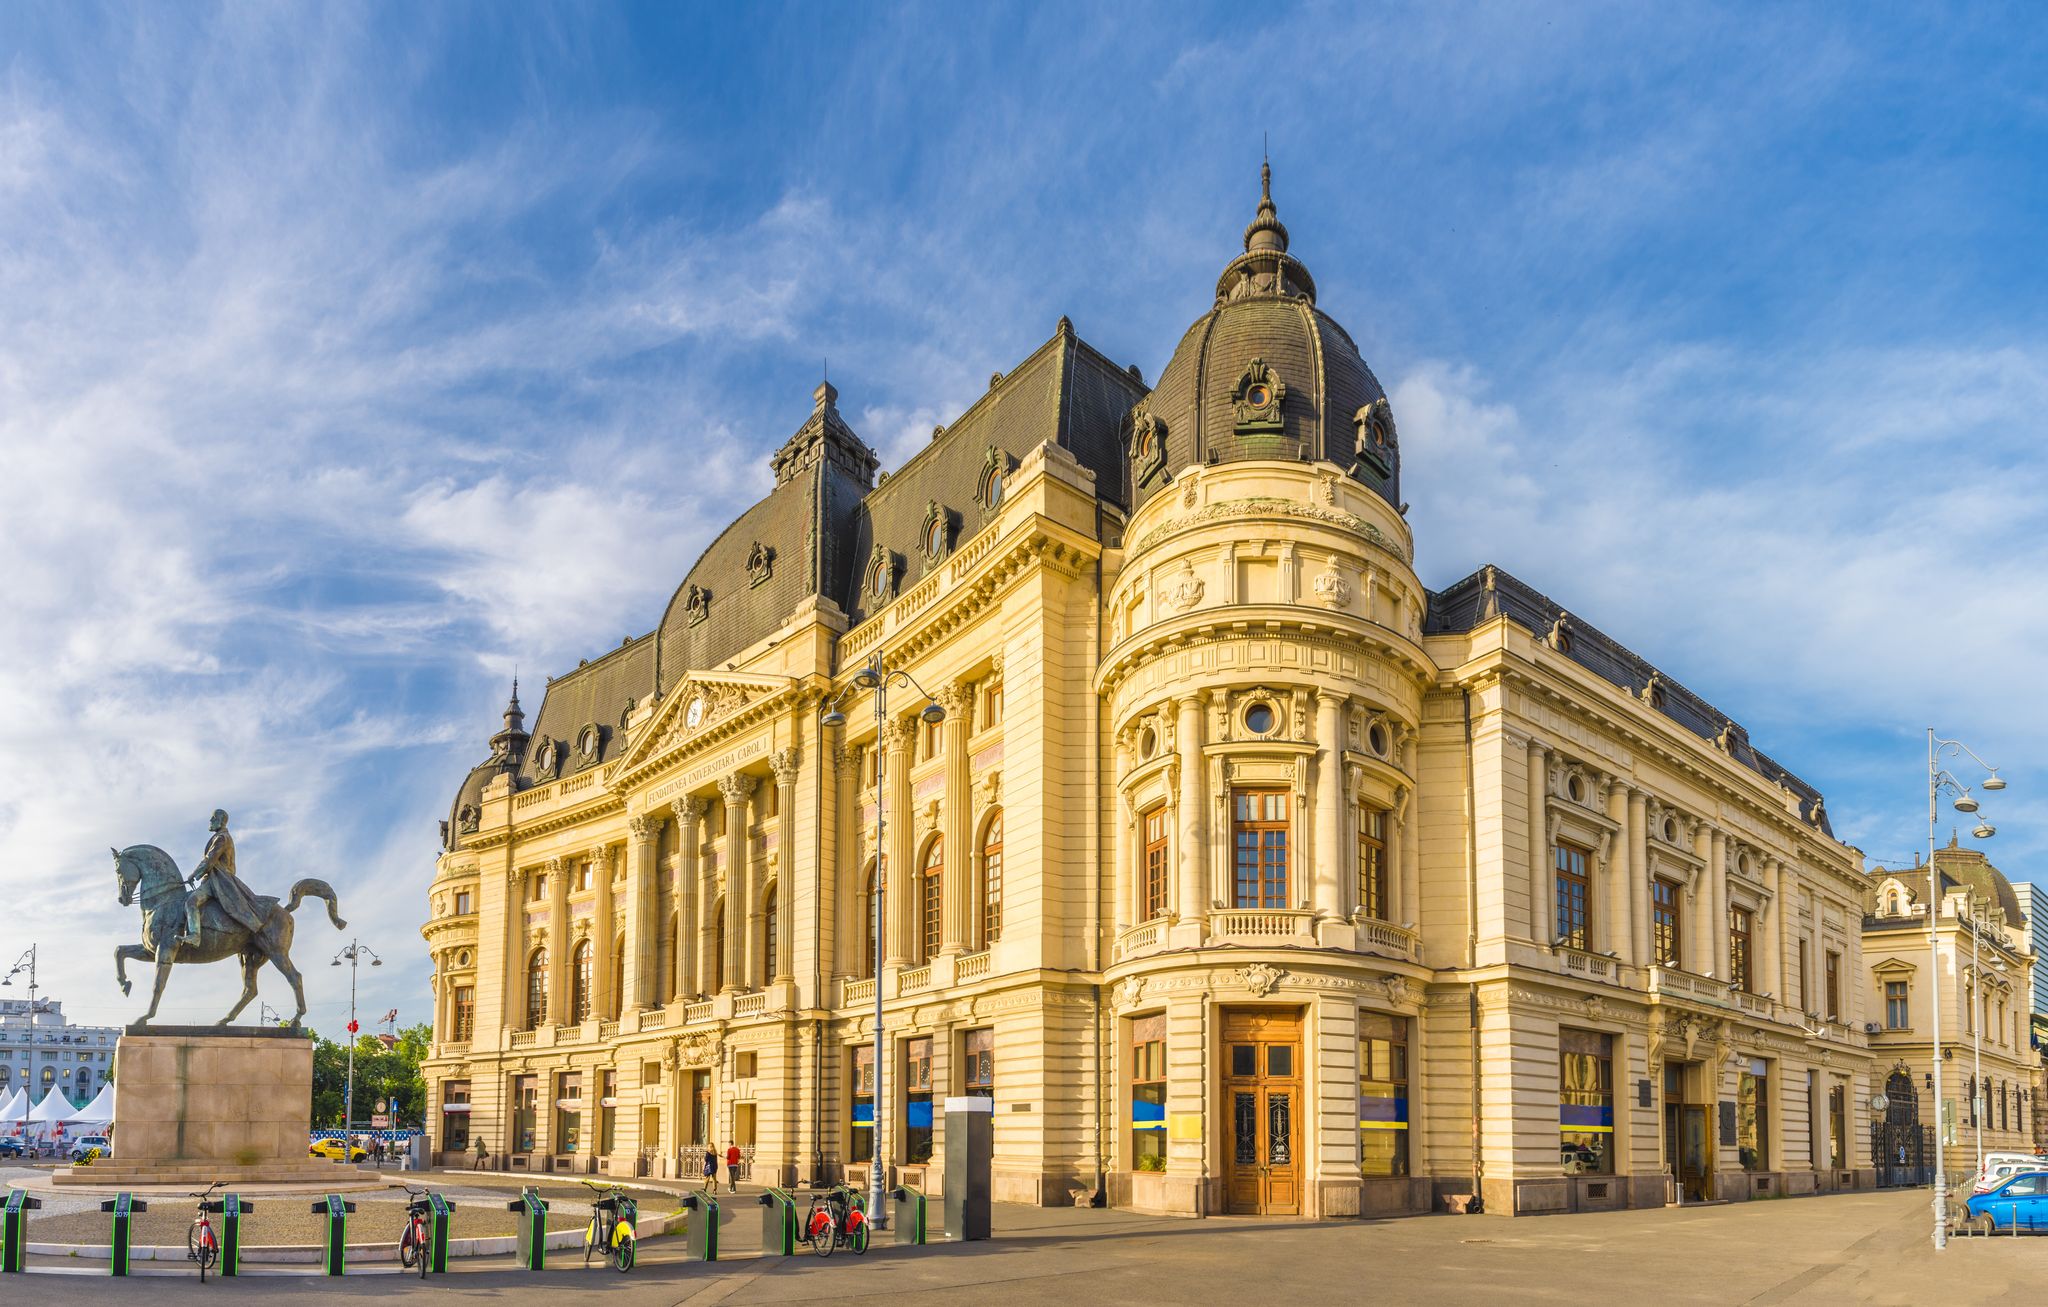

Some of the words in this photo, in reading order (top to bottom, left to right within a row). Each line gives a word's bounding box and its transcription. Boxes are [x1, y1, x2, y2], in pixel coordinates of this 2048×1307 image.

[688, 754, 735, 784] UNIVERSITARA
[737, 741, 761, 760] CAROL
[763, 737, 767, 749] I
